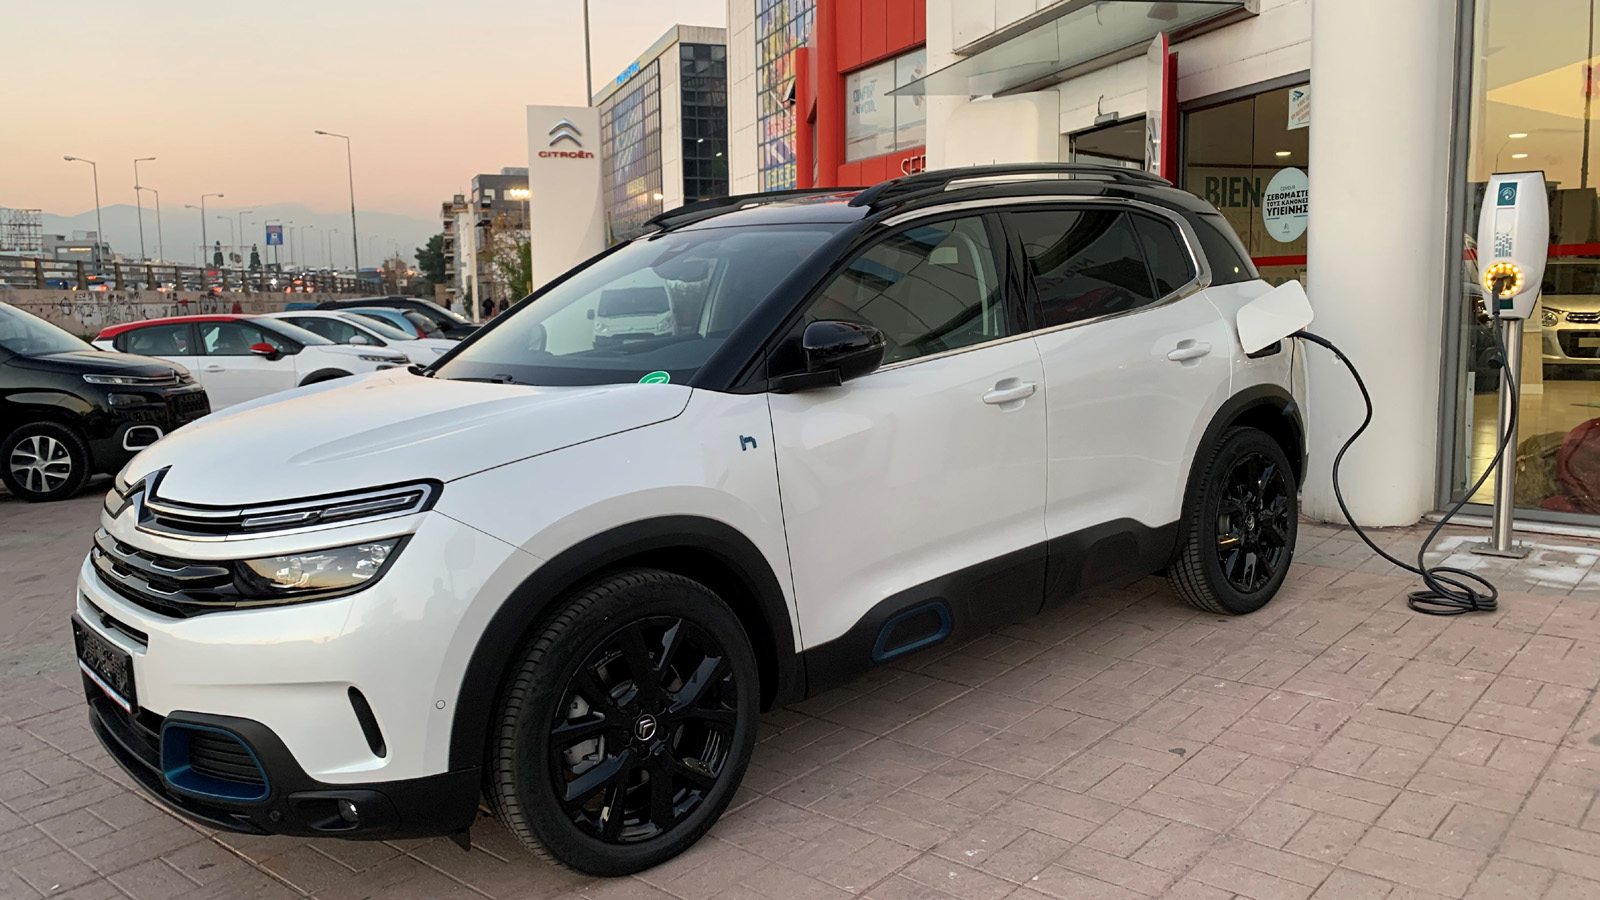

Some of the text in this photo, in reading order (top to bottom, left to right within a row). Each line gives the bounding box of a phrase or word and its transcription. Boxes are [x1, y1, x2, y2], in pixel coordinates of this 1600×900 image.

[1266, 189, 1309, 201] ΣΕΒΟΜΑΣΤΕ
[1281, 197, 1309, 206] ΚΑΝΟΝΕΣ
[1266, 204, 1309, 216] ΥΓΙΕΙΝΗΣ
